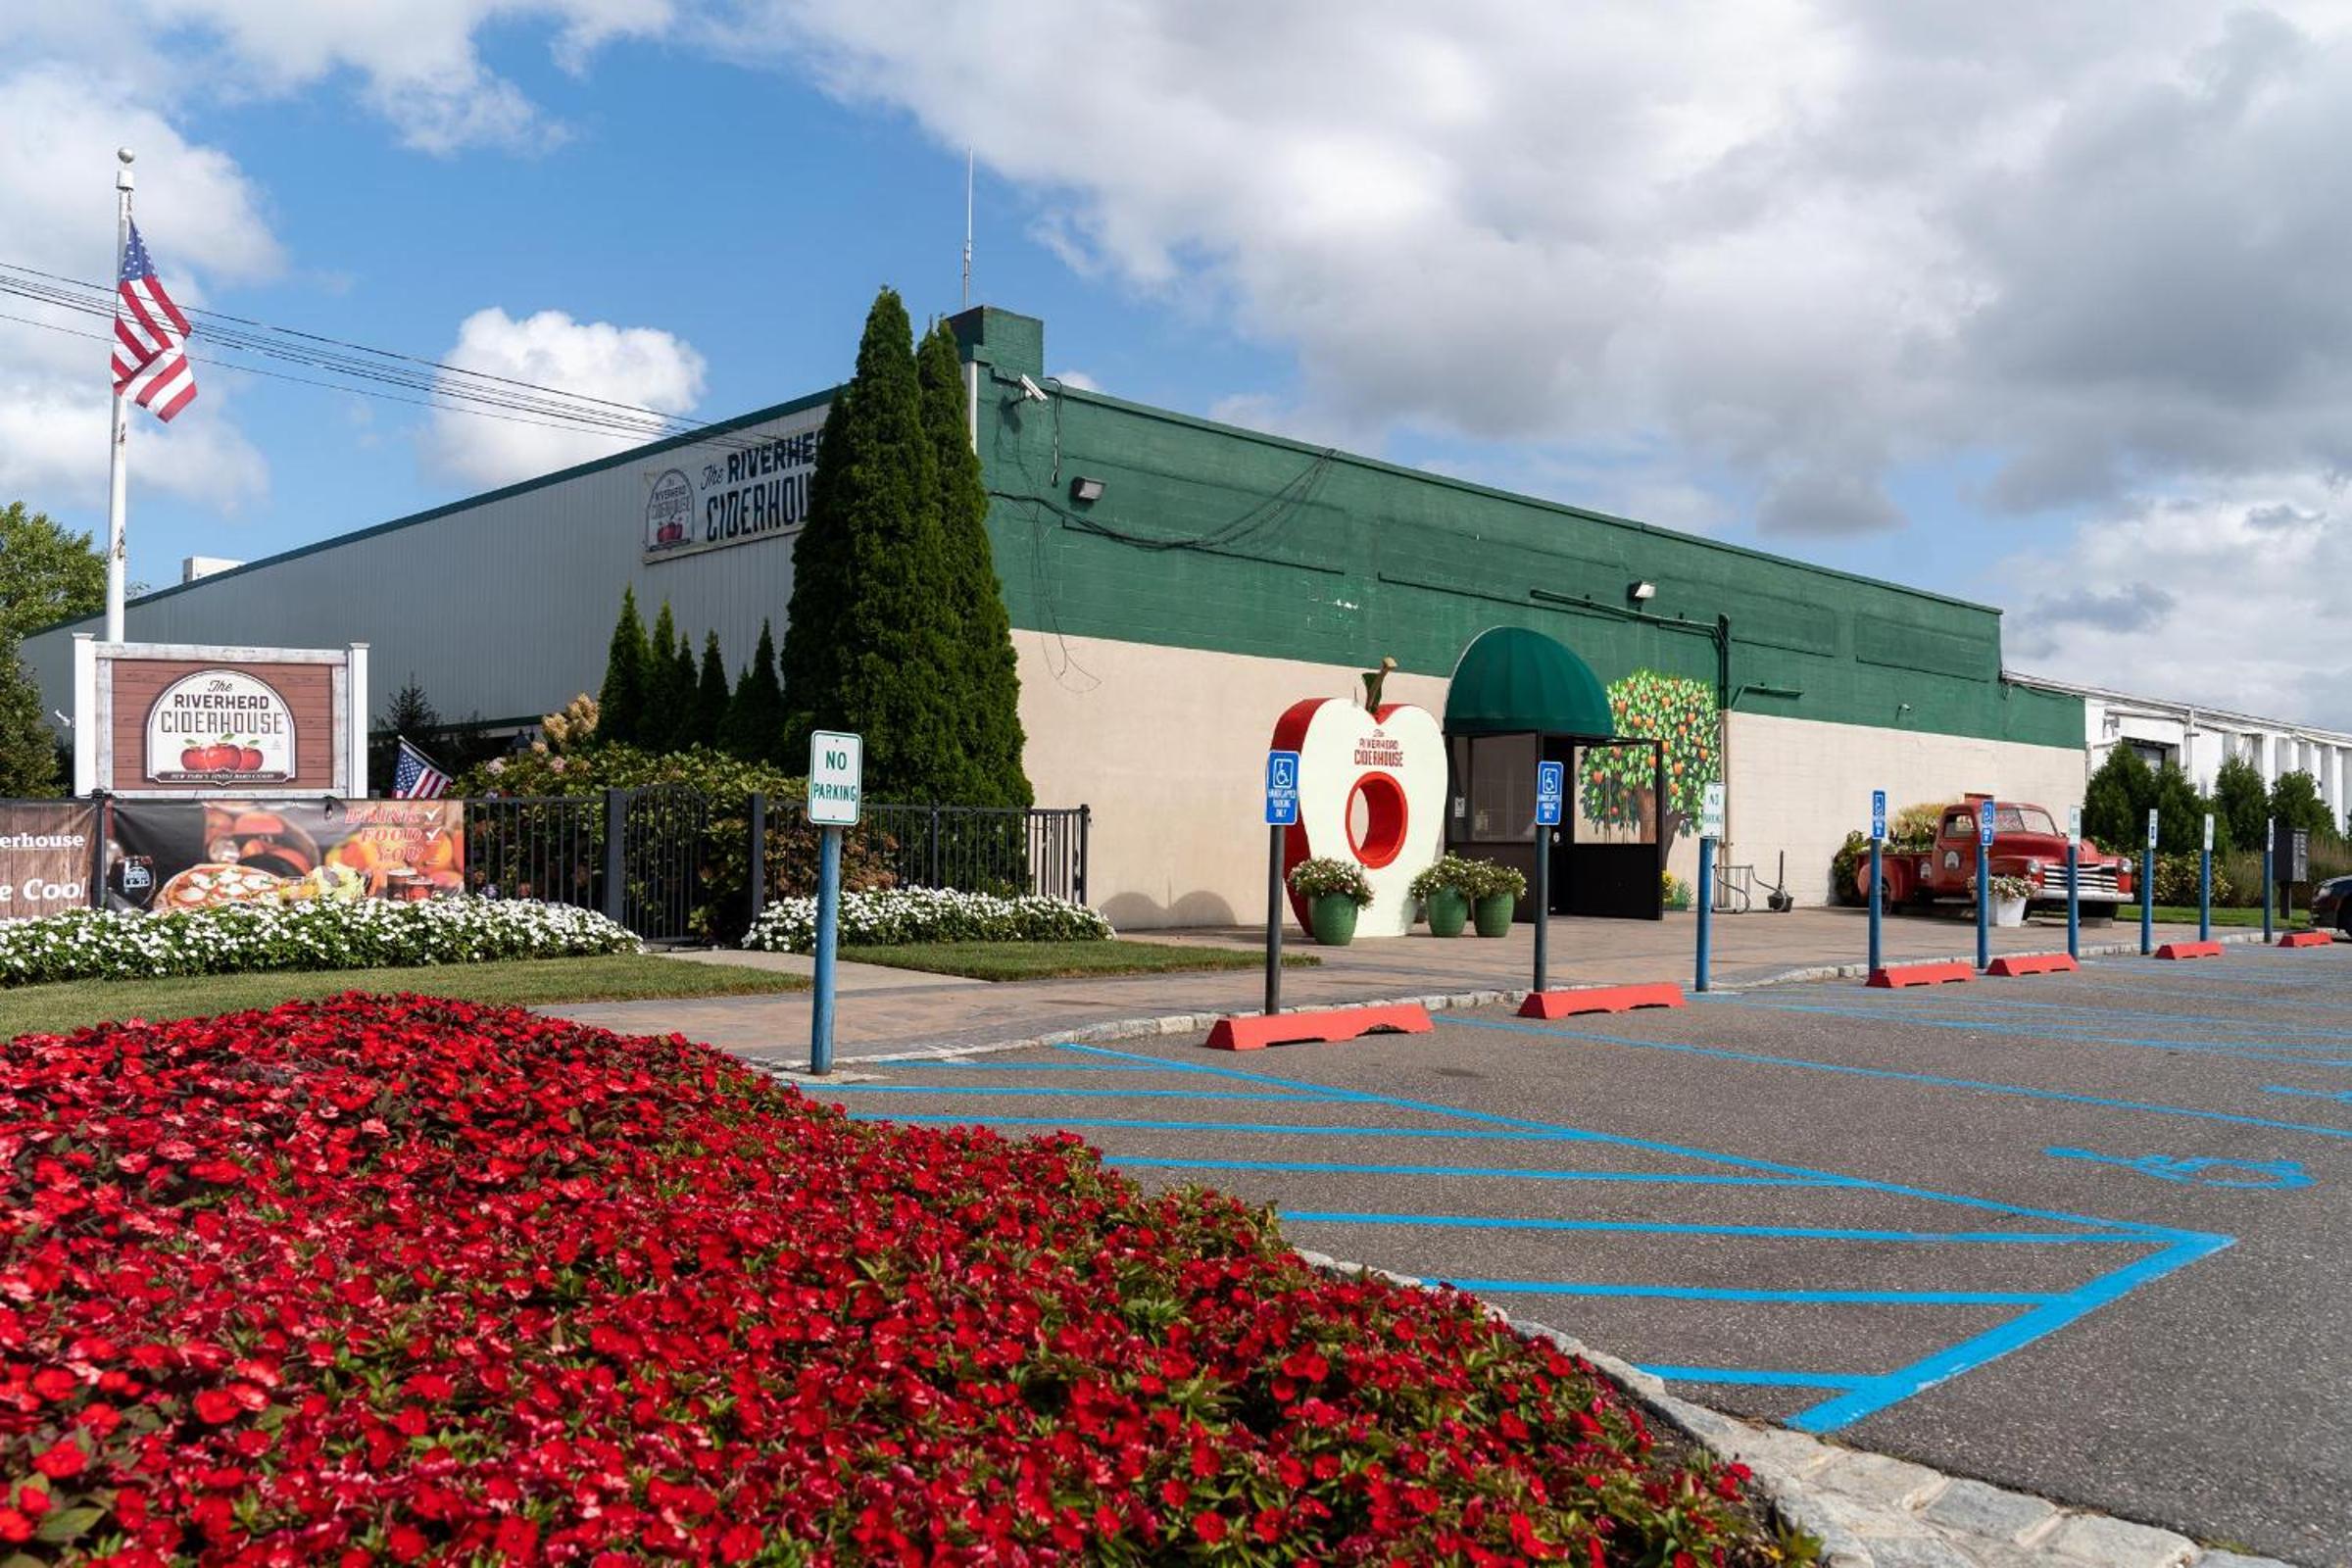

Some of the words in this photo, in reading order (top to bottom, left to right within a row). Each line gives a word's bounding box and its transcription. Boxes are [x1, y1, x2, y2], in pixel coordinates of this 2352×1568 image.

[701, 464, 723, 490] The
[207, 679, 233, 693] The
[174, 694, 270, 710] RIVERHEAD
[161, 710, 283, 734] CIDERHOUSE
[825, 751, 848, 770] NO
[1353, 749, 1403, 767] CIDERHOUSE
[813, 783, 858, 802] PARKING
[0, 832, 85, 848] erhouse
[361, 827, 423, 843] FOOD
